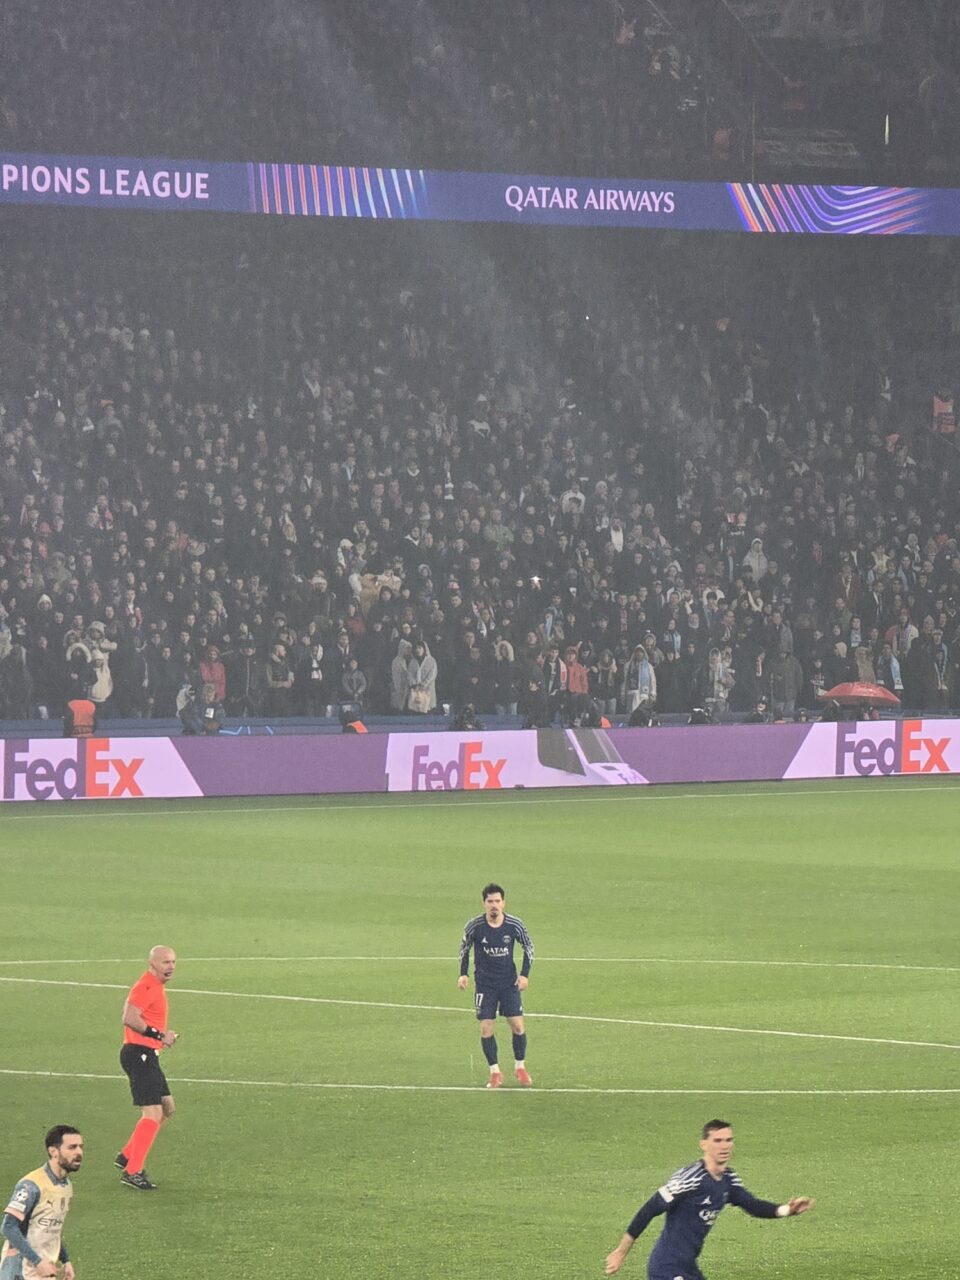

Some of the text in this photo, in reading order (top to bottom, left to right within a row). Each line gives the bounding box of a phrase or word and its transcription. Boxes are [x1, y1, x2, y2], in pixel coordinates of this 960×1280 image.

[2, 164, 210, 199] PIONS LEAGUE
[504, 184, 675, 214] QATAR AIRWAYS
[3, 738, 145, 800] FedEx
[412, 742, 507, 791] FedEx
[835, 720, 951, 776] FedEx
